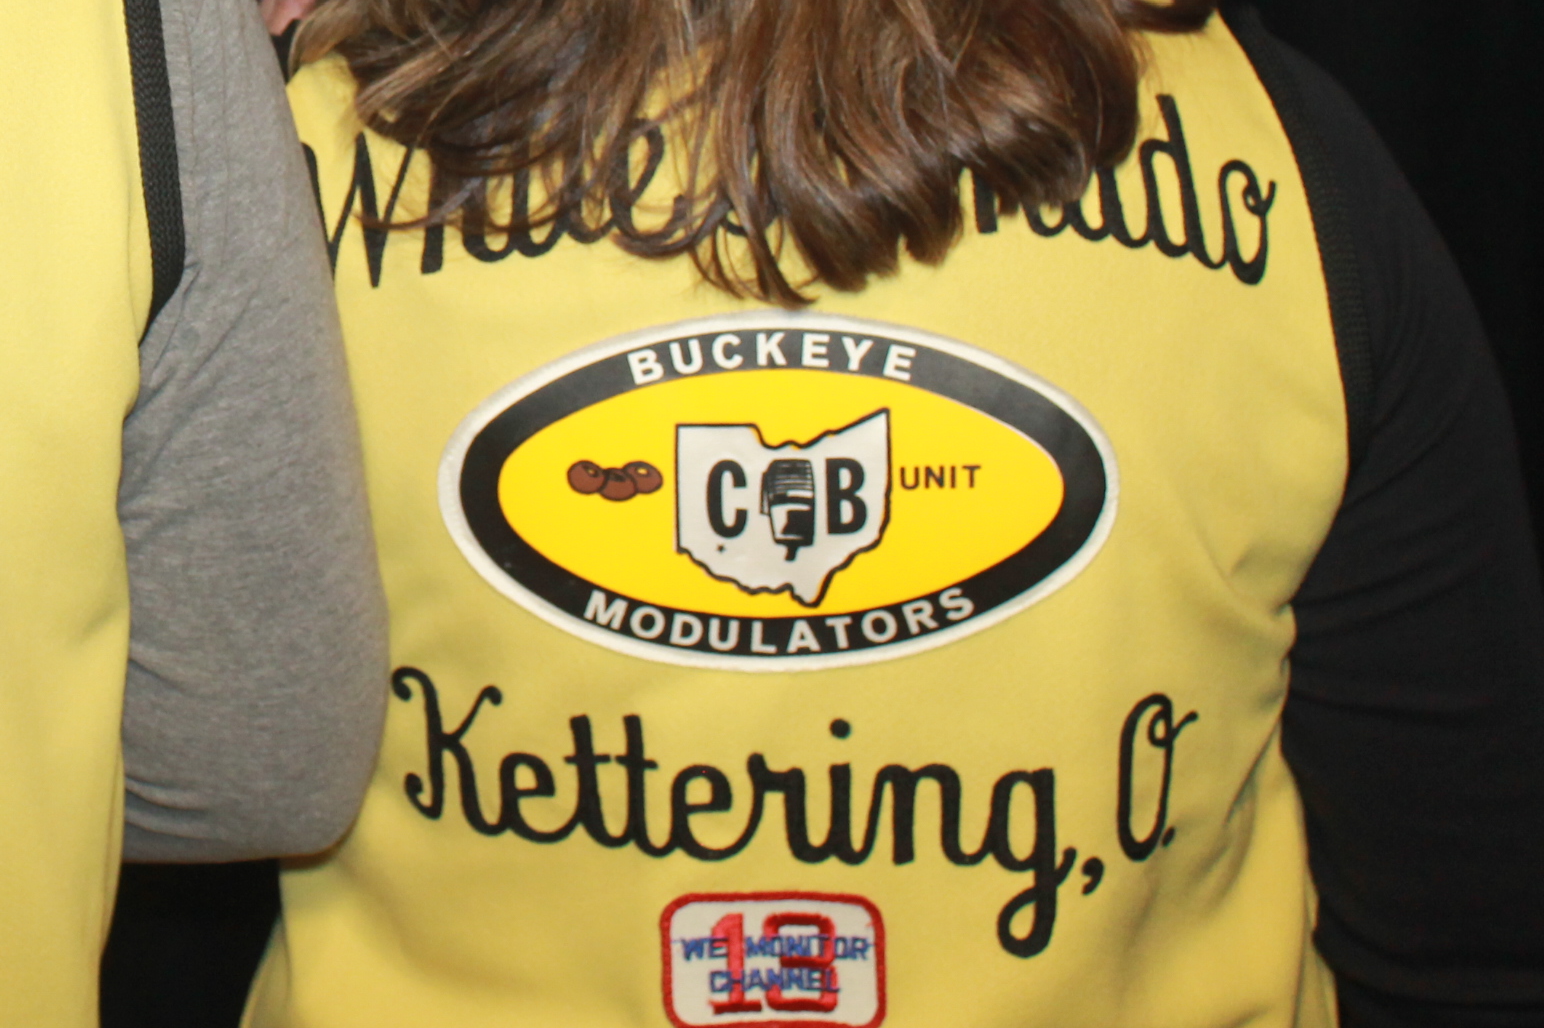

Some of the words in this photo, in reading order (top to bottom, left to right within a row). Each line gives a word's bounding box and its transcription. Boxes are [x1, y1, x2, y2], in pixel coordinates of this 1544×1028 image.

[627, 331, 916, 385] BUCKEYE
[899, 464, 982, 491] UNIT
[583, 588, 975, 656] MODULATORS
[391, 666, 1105, 958] Kettering,
[680, 936, 729, 962] WE
[744, 934, 870, 961] MONITOR
[709, 912, 839, 1016] 13
[708, 967, 841, 994] CHANNEL
